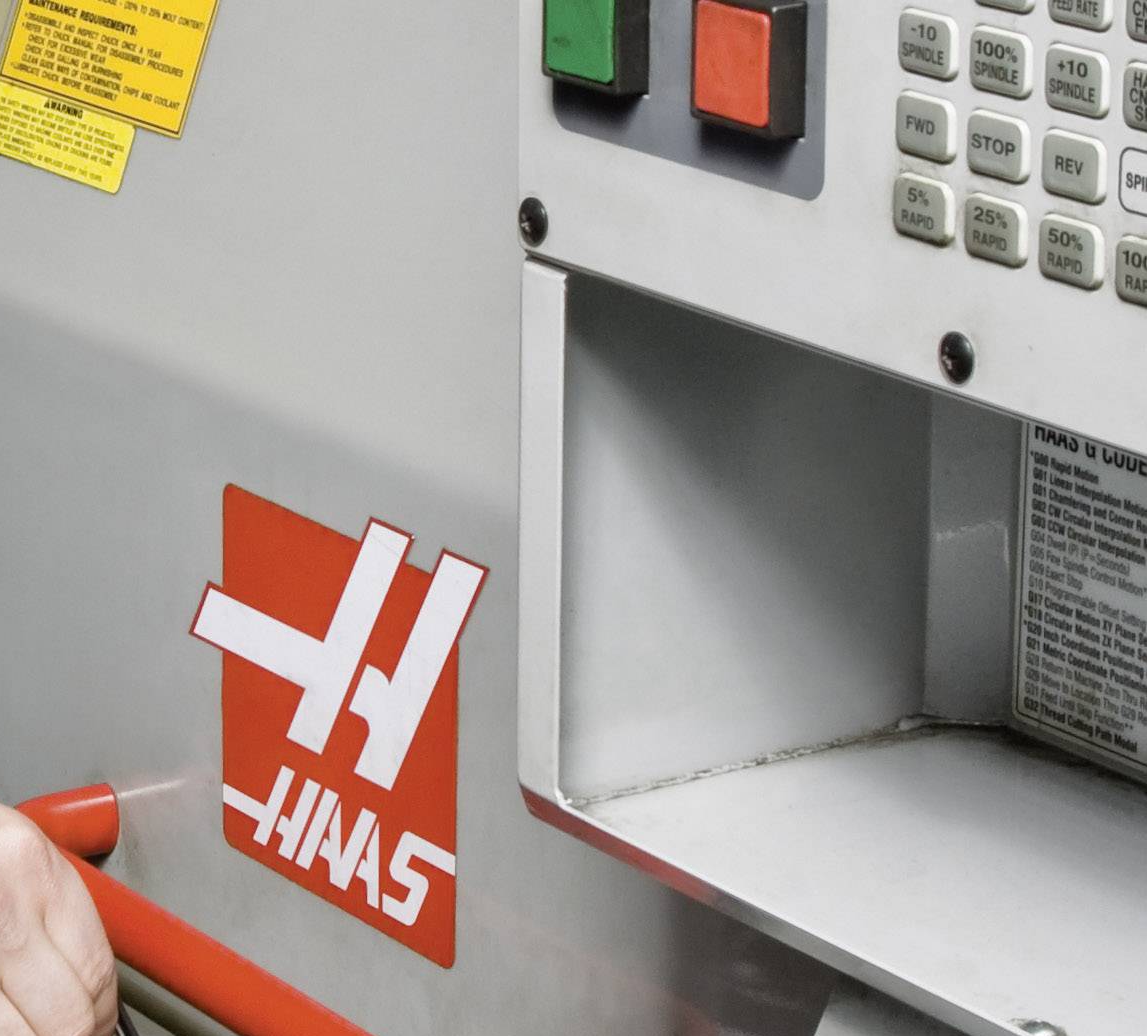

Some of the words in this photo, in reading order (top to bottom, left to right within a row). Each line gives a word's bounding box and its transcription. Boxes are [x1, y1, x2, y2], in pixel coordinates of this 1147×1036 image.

[28, 0, 78, 17] MAINTENANCE
[1076, 1, 1098, 18] RATE
[911, 23, 937, 42] -10
[902, 42, 944, 66] SPINDLE
[974, 39, 1018, 63] 100%
[974, 60, 1018, 86] SPINDLE
[1058, 60, 1088, 78] +10
[1049, 78, 1096, 103] SPINDLE
[49, 100, 84, 119] WARNING
[906, 114, 935, 136] FWD
[971, 133, 1016, 157] STOP
[1055, 155, 1084, 176] REV
[908, 188, 930, 207] 5%
[902, 210, 934, 231] RAPID
[974, 205, 1008, 230] 25%
[972, 230, 1008, 252] RAPID
[1048, 228, 1084, 252] 50%
[1047, 252, 1082, 274] RAPID
[1074, 466, 1099, 484] Motion
[223, 765, 455, 927] HAAS
